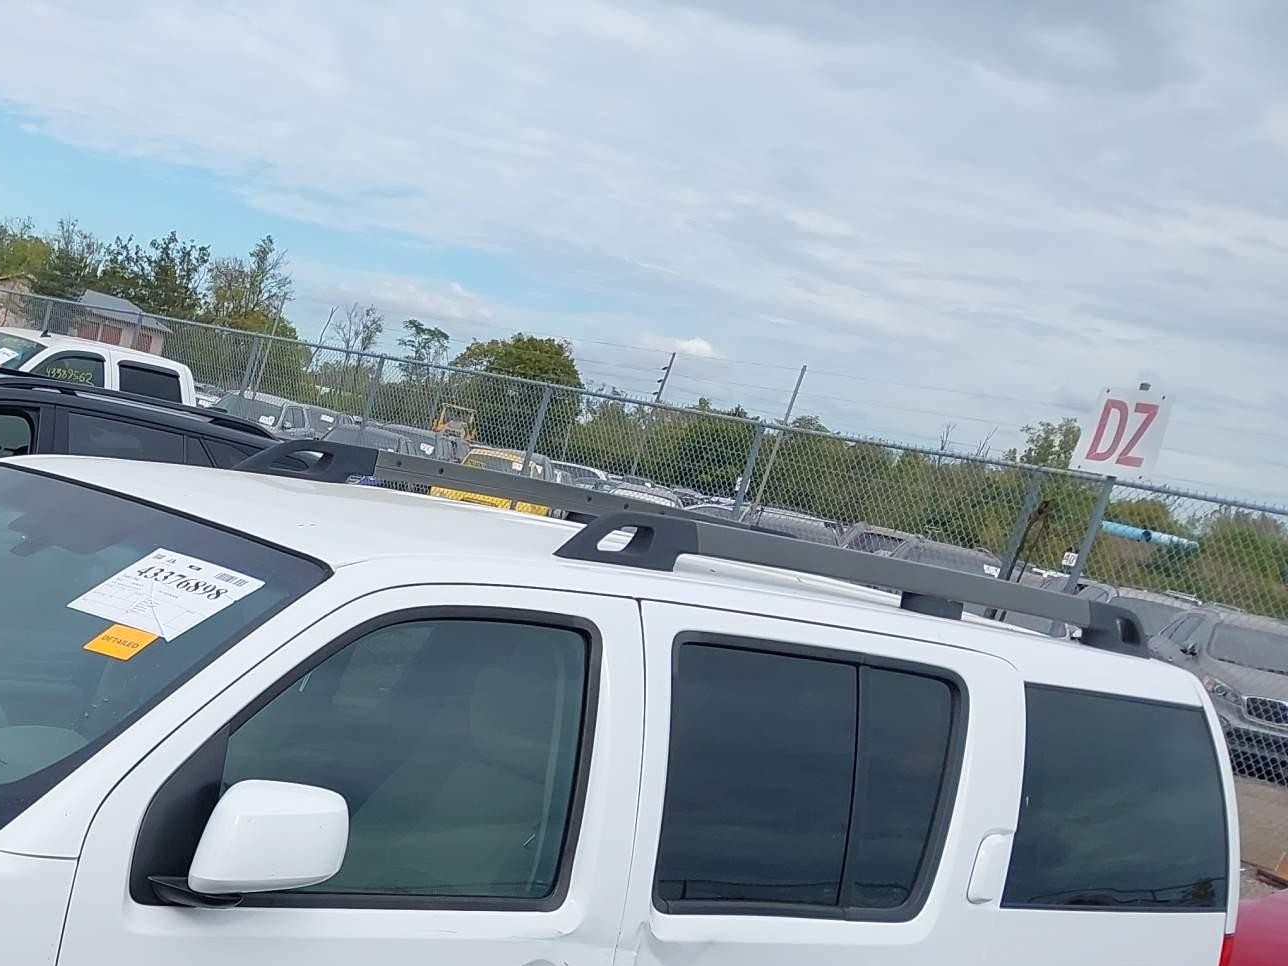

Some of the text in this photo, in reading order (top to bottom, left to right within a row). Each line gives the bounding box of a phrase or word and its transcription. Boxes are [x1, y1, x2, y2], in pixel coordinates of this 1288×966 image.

[1085, 399, 1160, 468] DZ
[136, 565, 229, 601] 43376898
[101, 634, 140, 649] DETAILED
